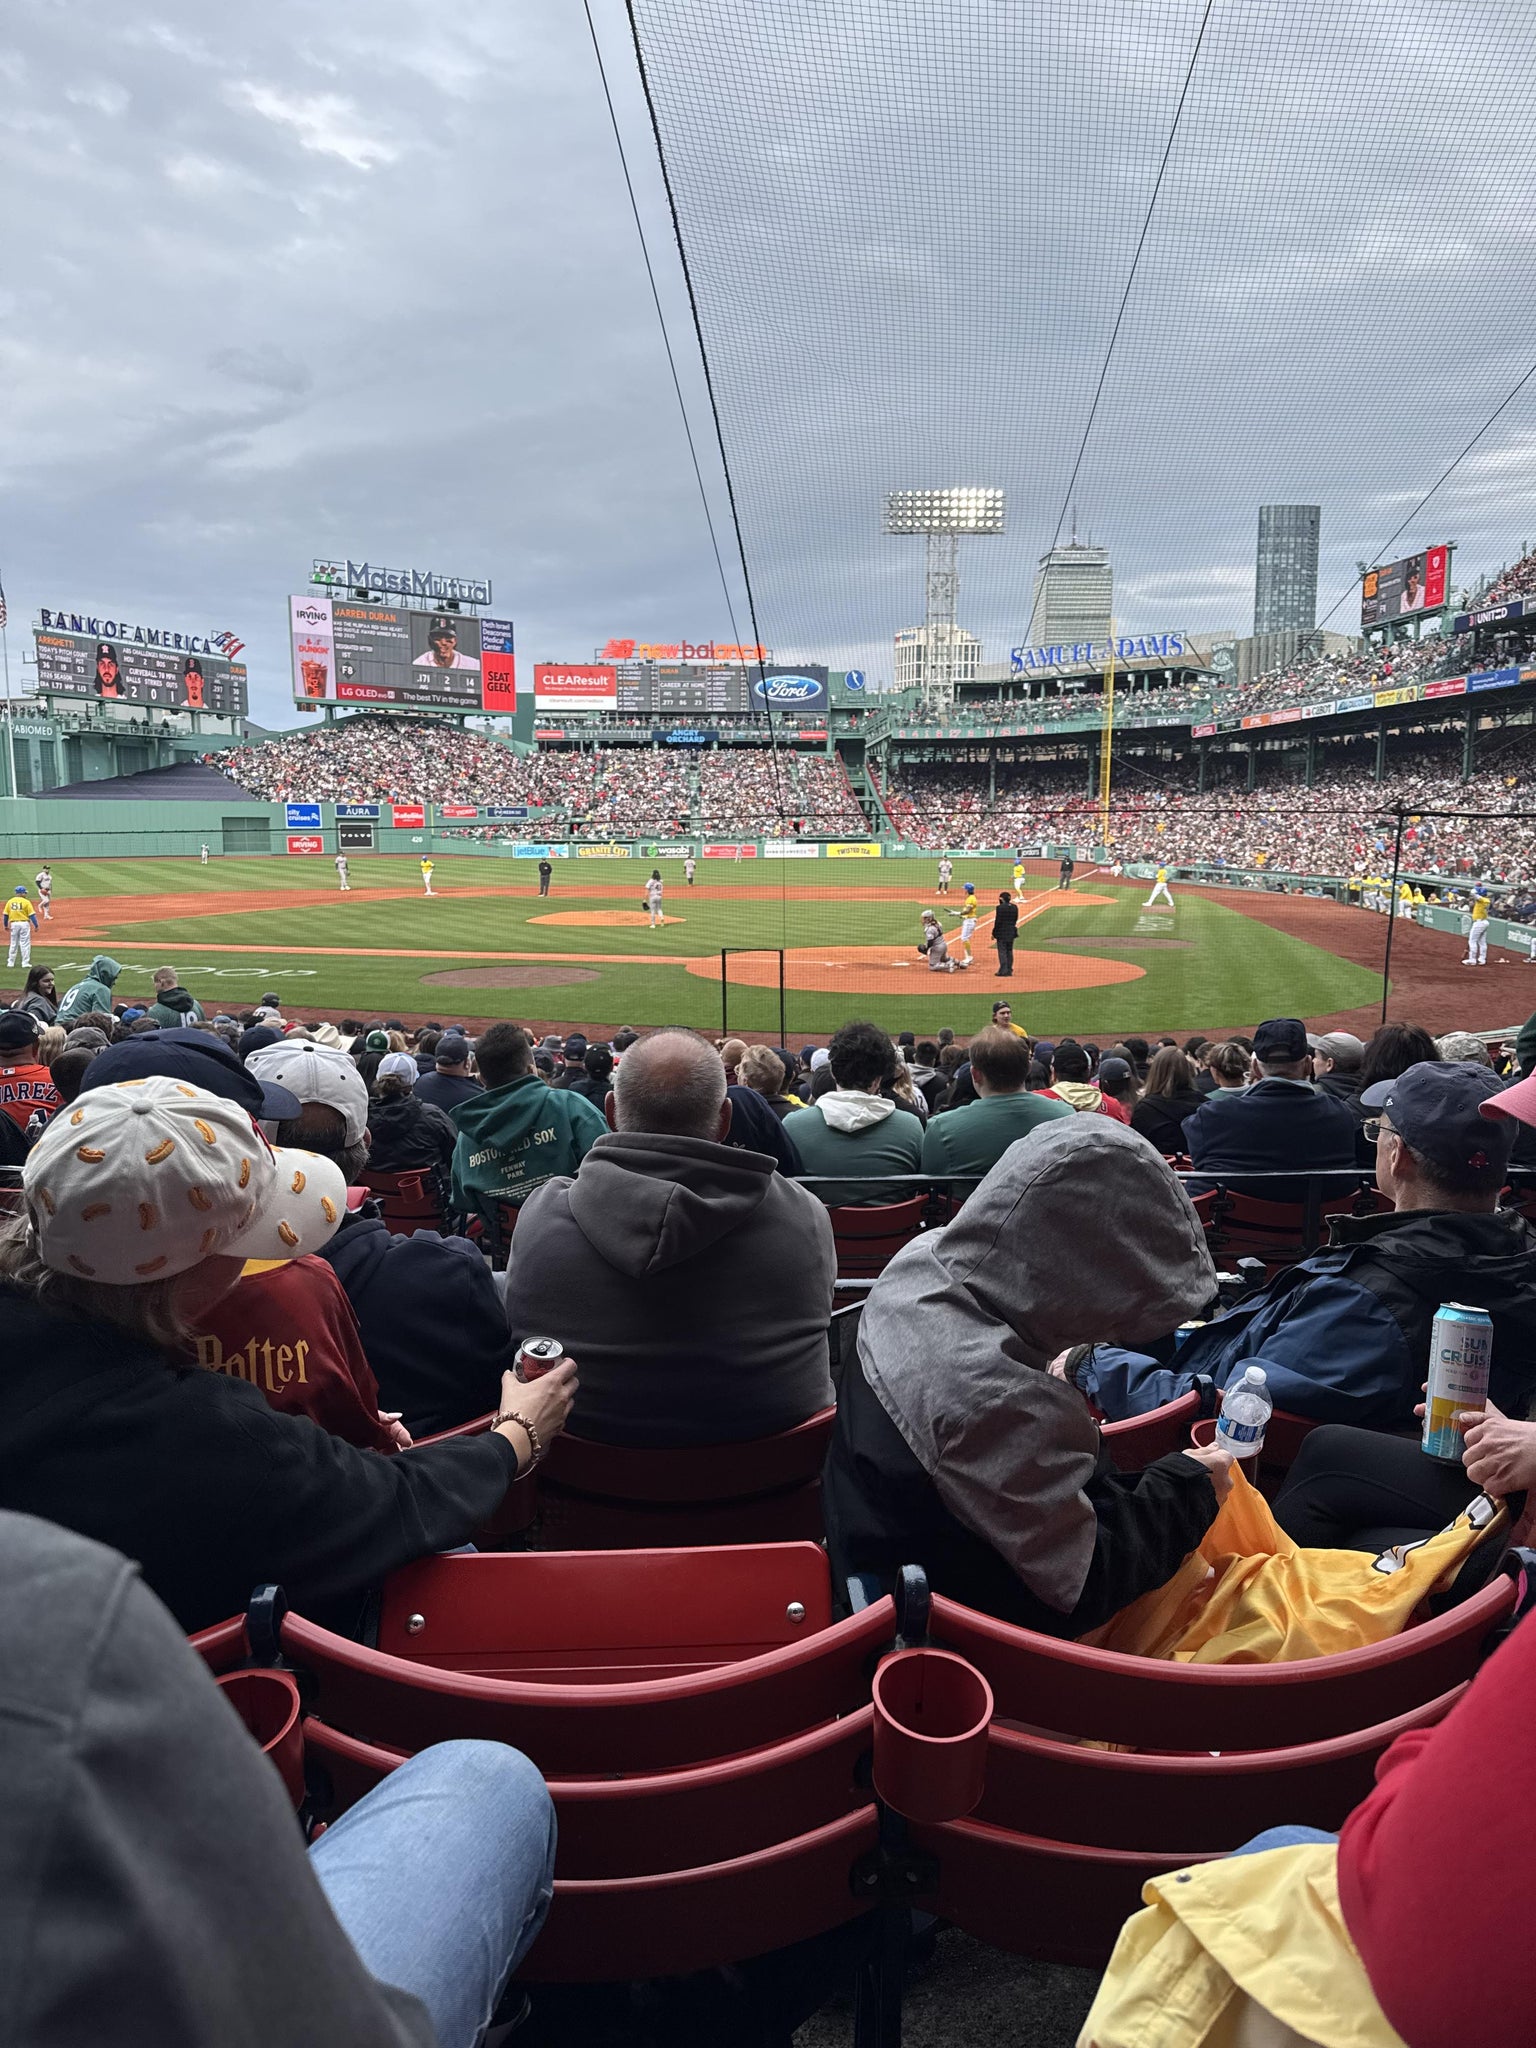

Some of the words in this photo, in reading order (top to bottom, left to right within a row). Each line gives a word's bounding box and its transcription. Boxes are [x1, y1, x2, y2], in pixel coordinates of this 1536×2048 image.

[345, 560, 492, 605] MassMutual
[296, 609, 327, 621] IRVING
[334, 608, 367, 619] JARREN
[369, 611, 396, 623] DURAN
[41, 608, 97, 635] BANK
[104, 620, 127, 639] OF
[134, 626, 211, 654] AMERICA
[482, 636, 504, 644] Medical
[639, 643, 679, 659] new
[682, 639, 767, 660] balance
[1010, 641, 1098, 674] SAMUEL
[1102, 632, 1184, 659] ADAMS
[129, 668, 157, 678] CURVEBALL
[342, 666, 353, 675] F8
[487, 671, 510, 682] SEAT
[126, 676, 141, 684] BALLS
[166, 681, 178, 689] OUTS
[444, 676, 450, 684] 2
[466, 678, 474, 686] 14
[542, 675, 609, 685] CLEAResult
[341, 687, 353, 696] LG
[355, 688, 378, 698] OLED
[487, 682, 511, 693] GEEK
[768, 679, 808, 698] Ford
[131, 686, 138, 698] 2
[151, 688, 157, 700] 0
[171, 691, 175, 702] 1
[403, 692, 416, 700] The
[417, 693, 431, 701] best
[432, 694, 441, 702] TV
[442, 695, 448, 703] in
[448, 696, 459, 704] the
[460, 698, 478, 706] game
[14, 724, 53, 736] ABIOMED
[671, 729, 700, 737] ANGRY
[666, 735, 706, 743] ORCHARD
[292, 841, 318, 849] IRVING
[517, 846, 546, 856] jetBlue
[578, 846, 612, 857] GRANITE
[613, 845, 629, 857] CITY
[658, 846, 690, 854] wasabi
[860, 847, 871, 855] TEA
[11, 902, 23, 911] 81
[58, 988, 80, 1011] 19
[0, 1081, 58, 1105] AREZ
[469, 1144, 505, 1168] BOSTO
[533, 1127, 557, 1146] SOX
[501, 1161, 526, 1175] FENWAY
[506, 1169, 525, 1180] PARK
[195, 1334, 310, 1394] Potter
